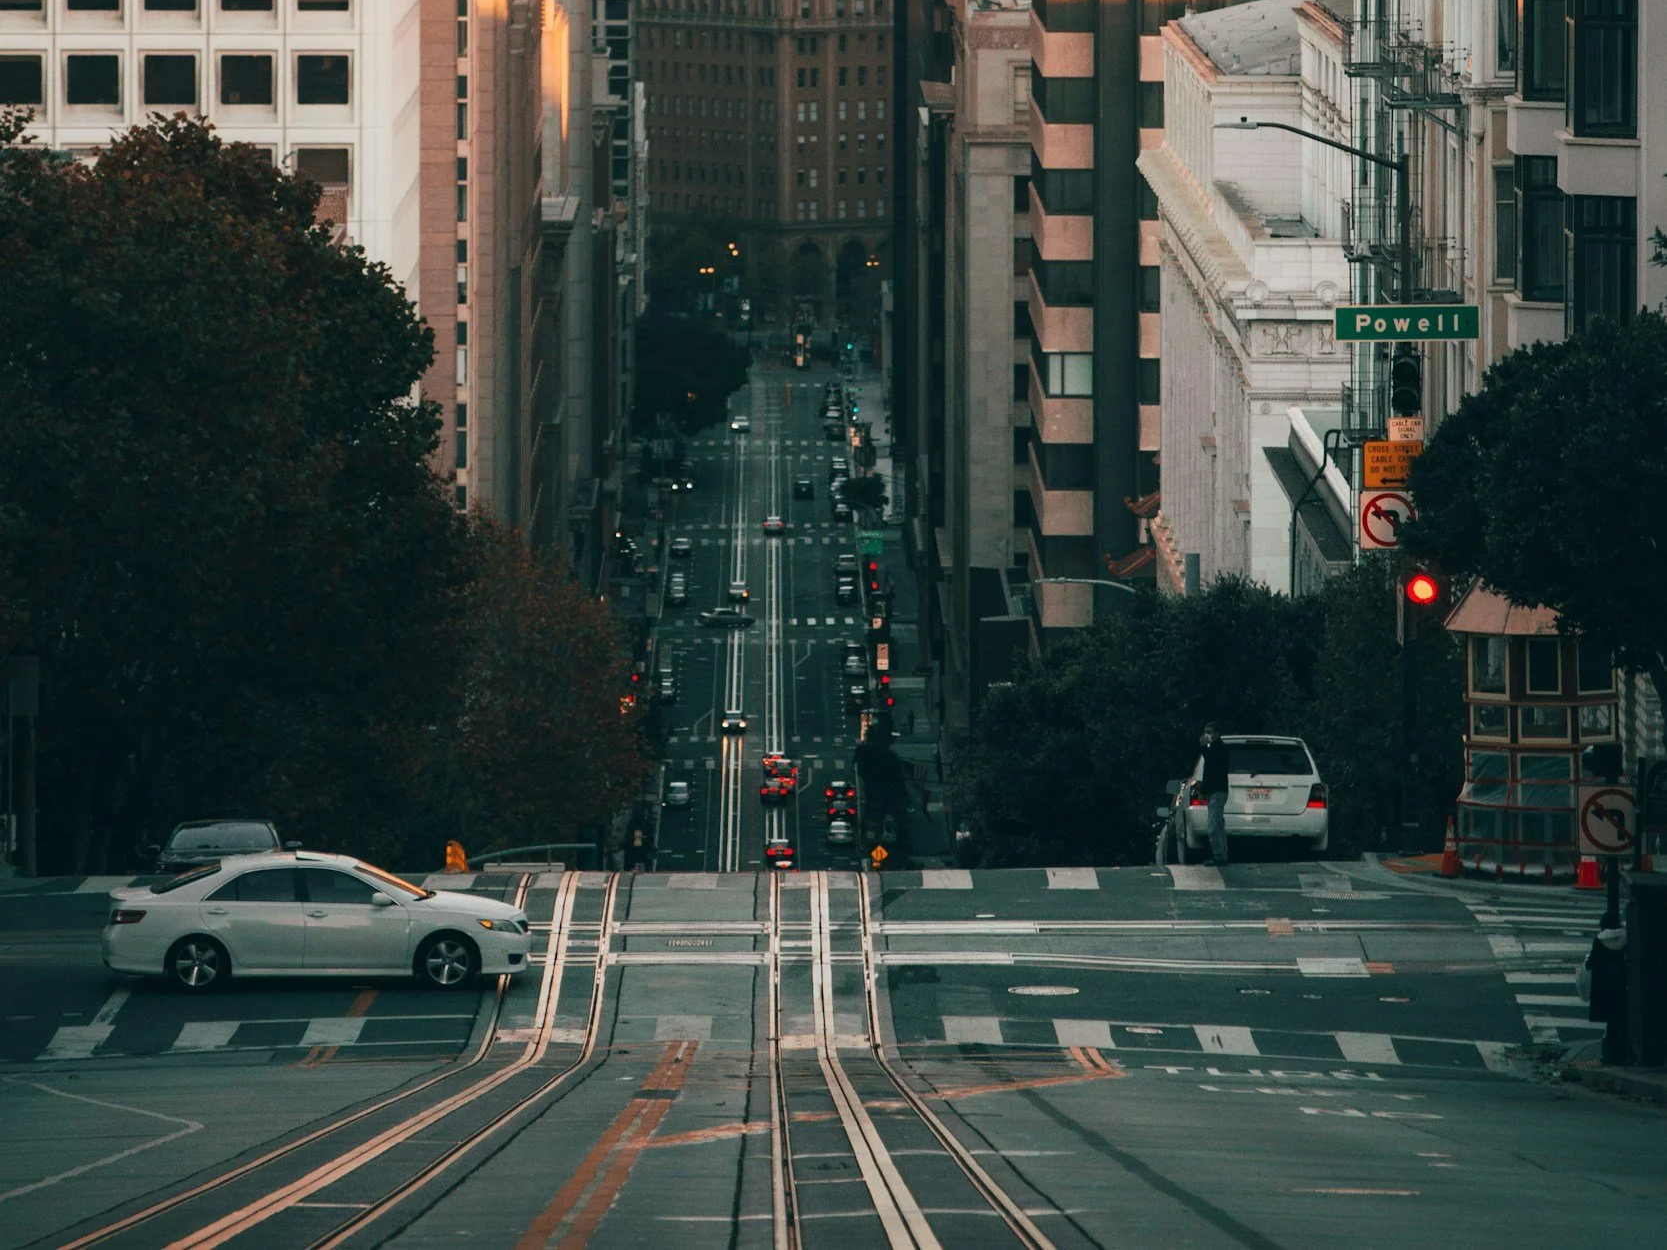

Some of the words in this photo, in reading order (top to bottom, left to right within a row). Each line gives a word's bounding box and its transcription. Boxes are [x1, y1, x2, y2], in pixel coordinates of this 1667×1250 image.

[1355, 314, 1459, 333] Powell
[1370, 465, 1379, 473] DO
[1383, 465, 1396, 473] NOT
